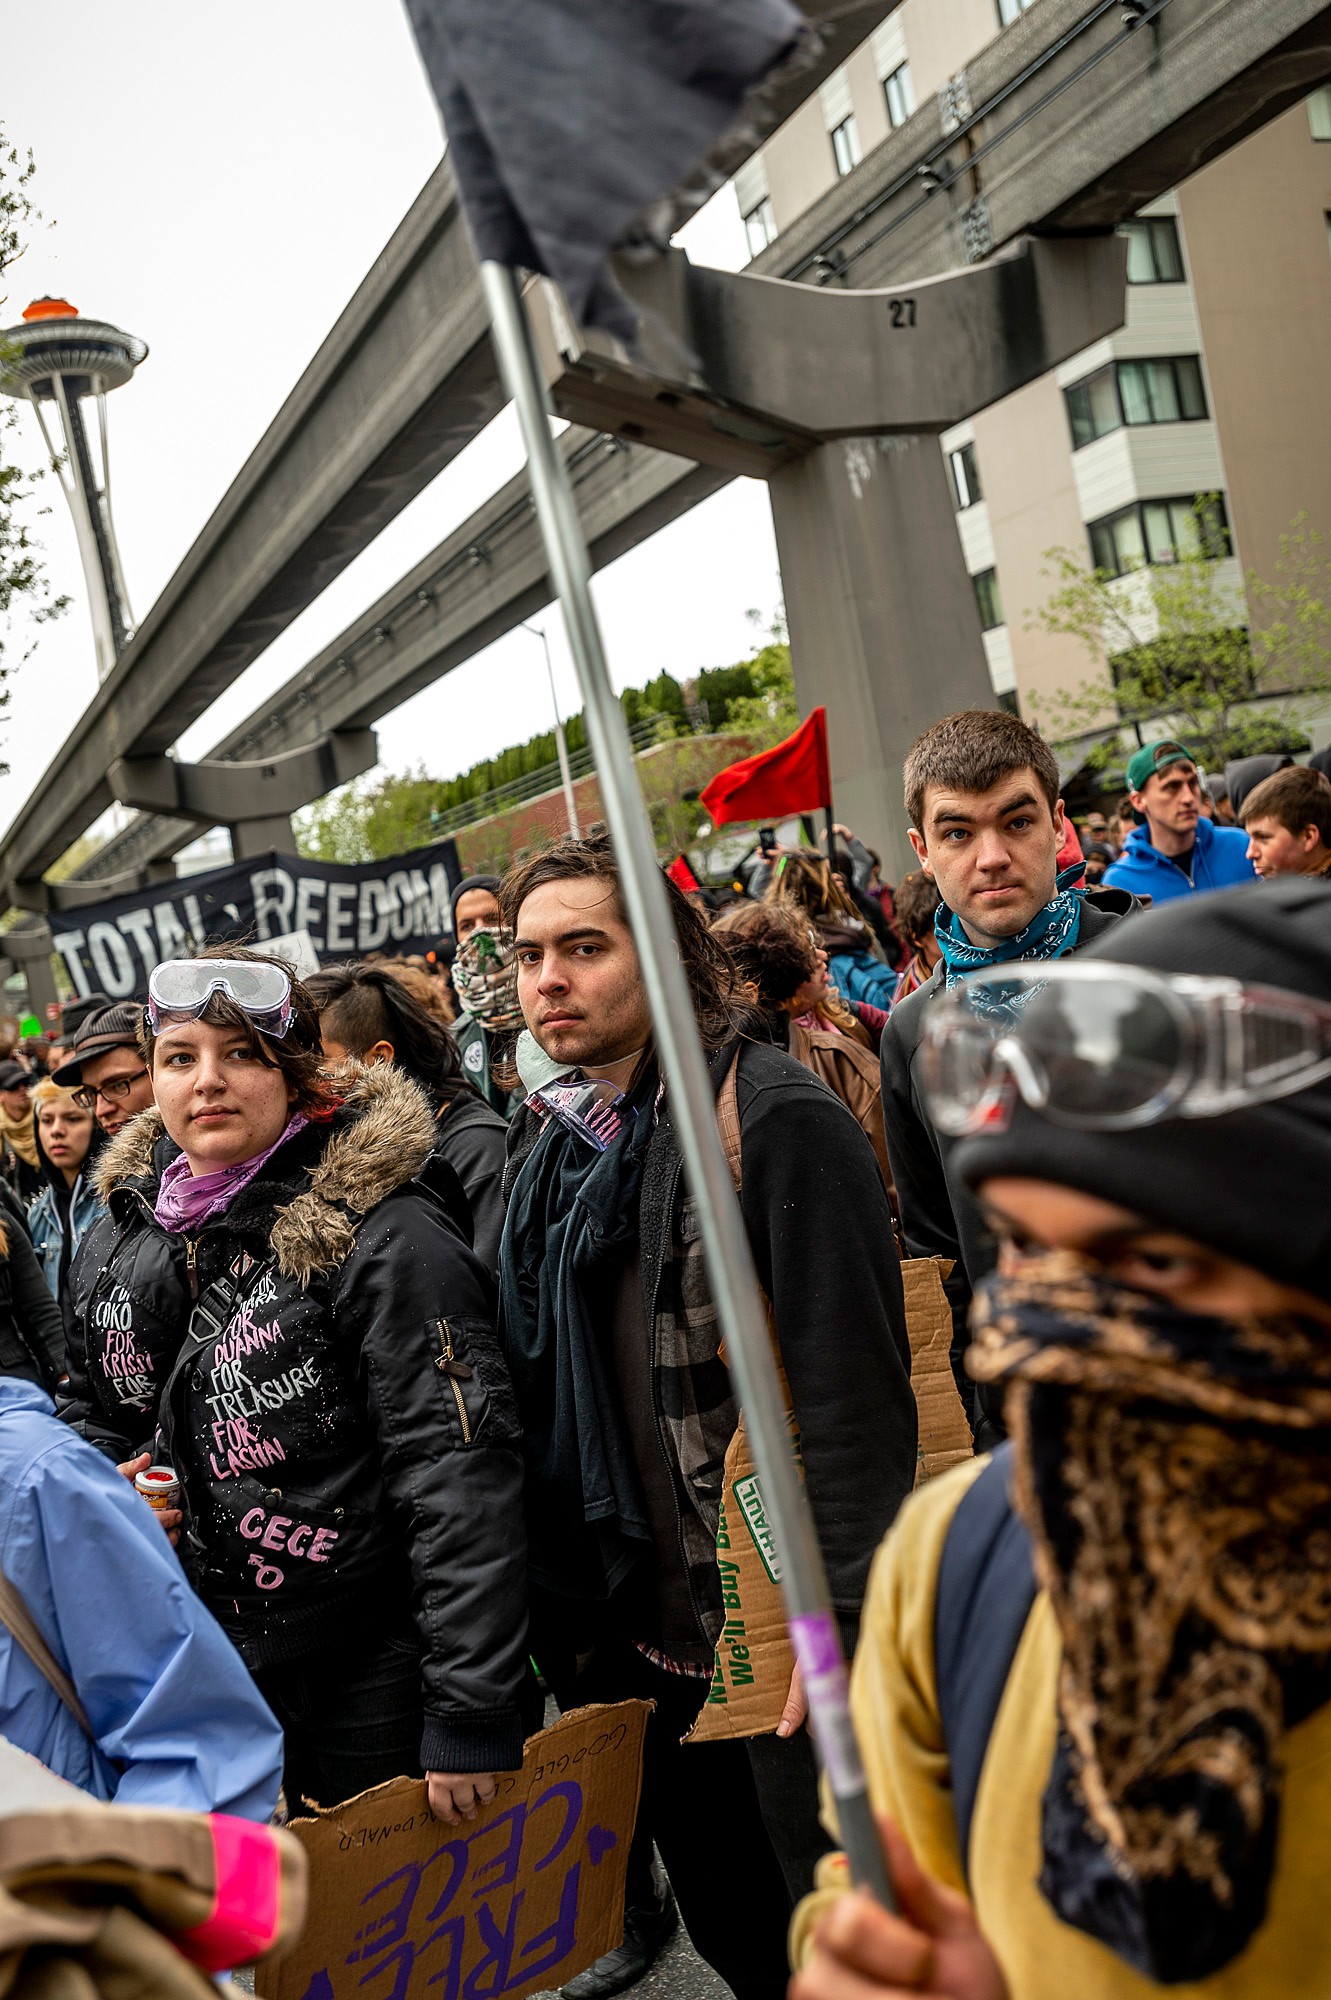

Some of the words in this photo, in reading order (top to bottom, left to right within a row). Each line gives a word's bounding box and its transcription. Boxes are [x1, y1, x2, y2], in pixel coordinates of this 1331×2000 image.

[888, 298, 917, 329] 27
[238, 862, 452, 952] REEDOM
[95, 1301, 132, 1331] COKO
[222, 1308, 257, 1344] FOR
[106, 1330, 136, 1355] FOR
[112, 1374, 157, 1399] FOR
[205, 1356, 322, 1421] TREASURE
[210, 1359, 254, 1395] FOR
[212, 1417, 258, 1454] FOR
[239, 1506, 339, 1564] CECE
[717, 1558, 742, 1610] Buy
[723, 1620, 755, 1687] We'll
[533, 1723, 627, 1782] GOOGLE
[345, 1780, 583, 1966] CECE
[356, 1859, 583, 2000] FREE
